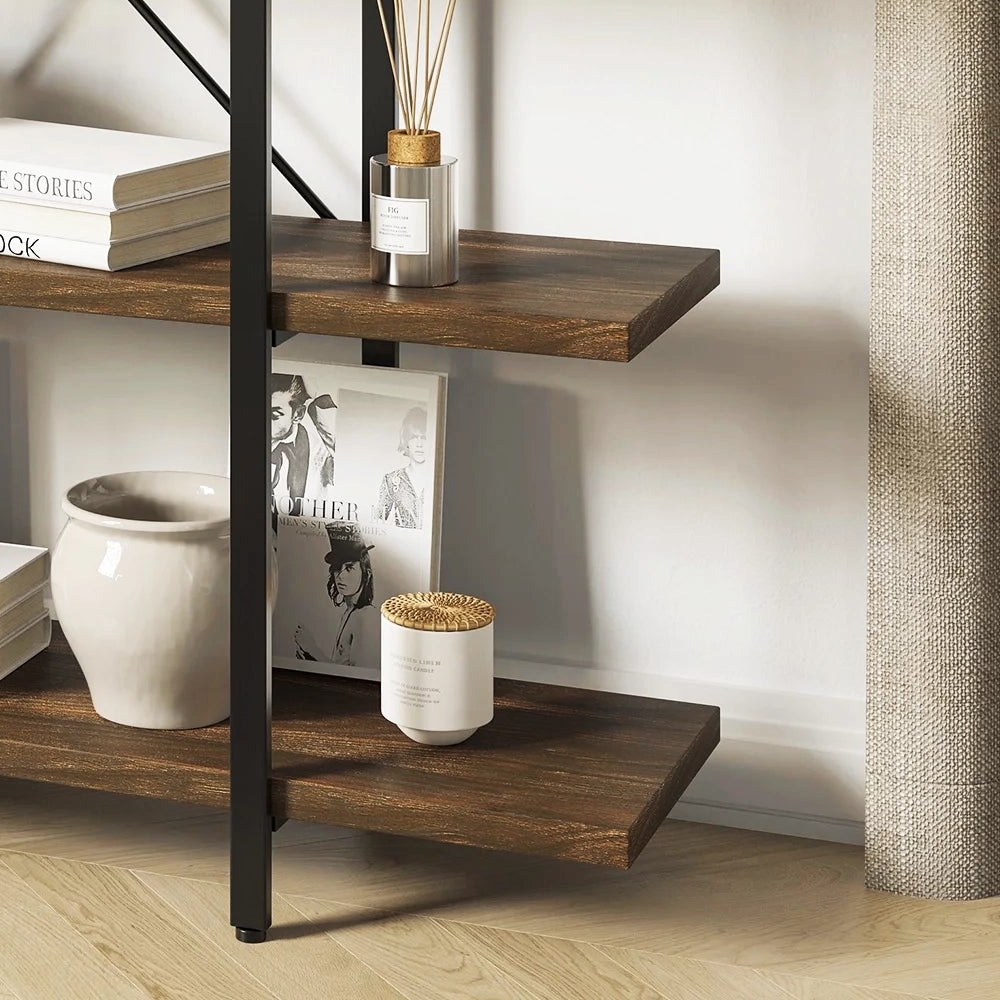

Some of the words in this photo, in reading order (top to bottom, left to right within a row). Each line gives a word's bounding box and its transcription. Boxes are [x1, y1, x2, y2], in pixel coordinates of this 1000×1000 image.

[13, 171, 93, 202] STORIES
[387, 206, 399, 214] FIG
[271, 494, 359, 521] OTHER
